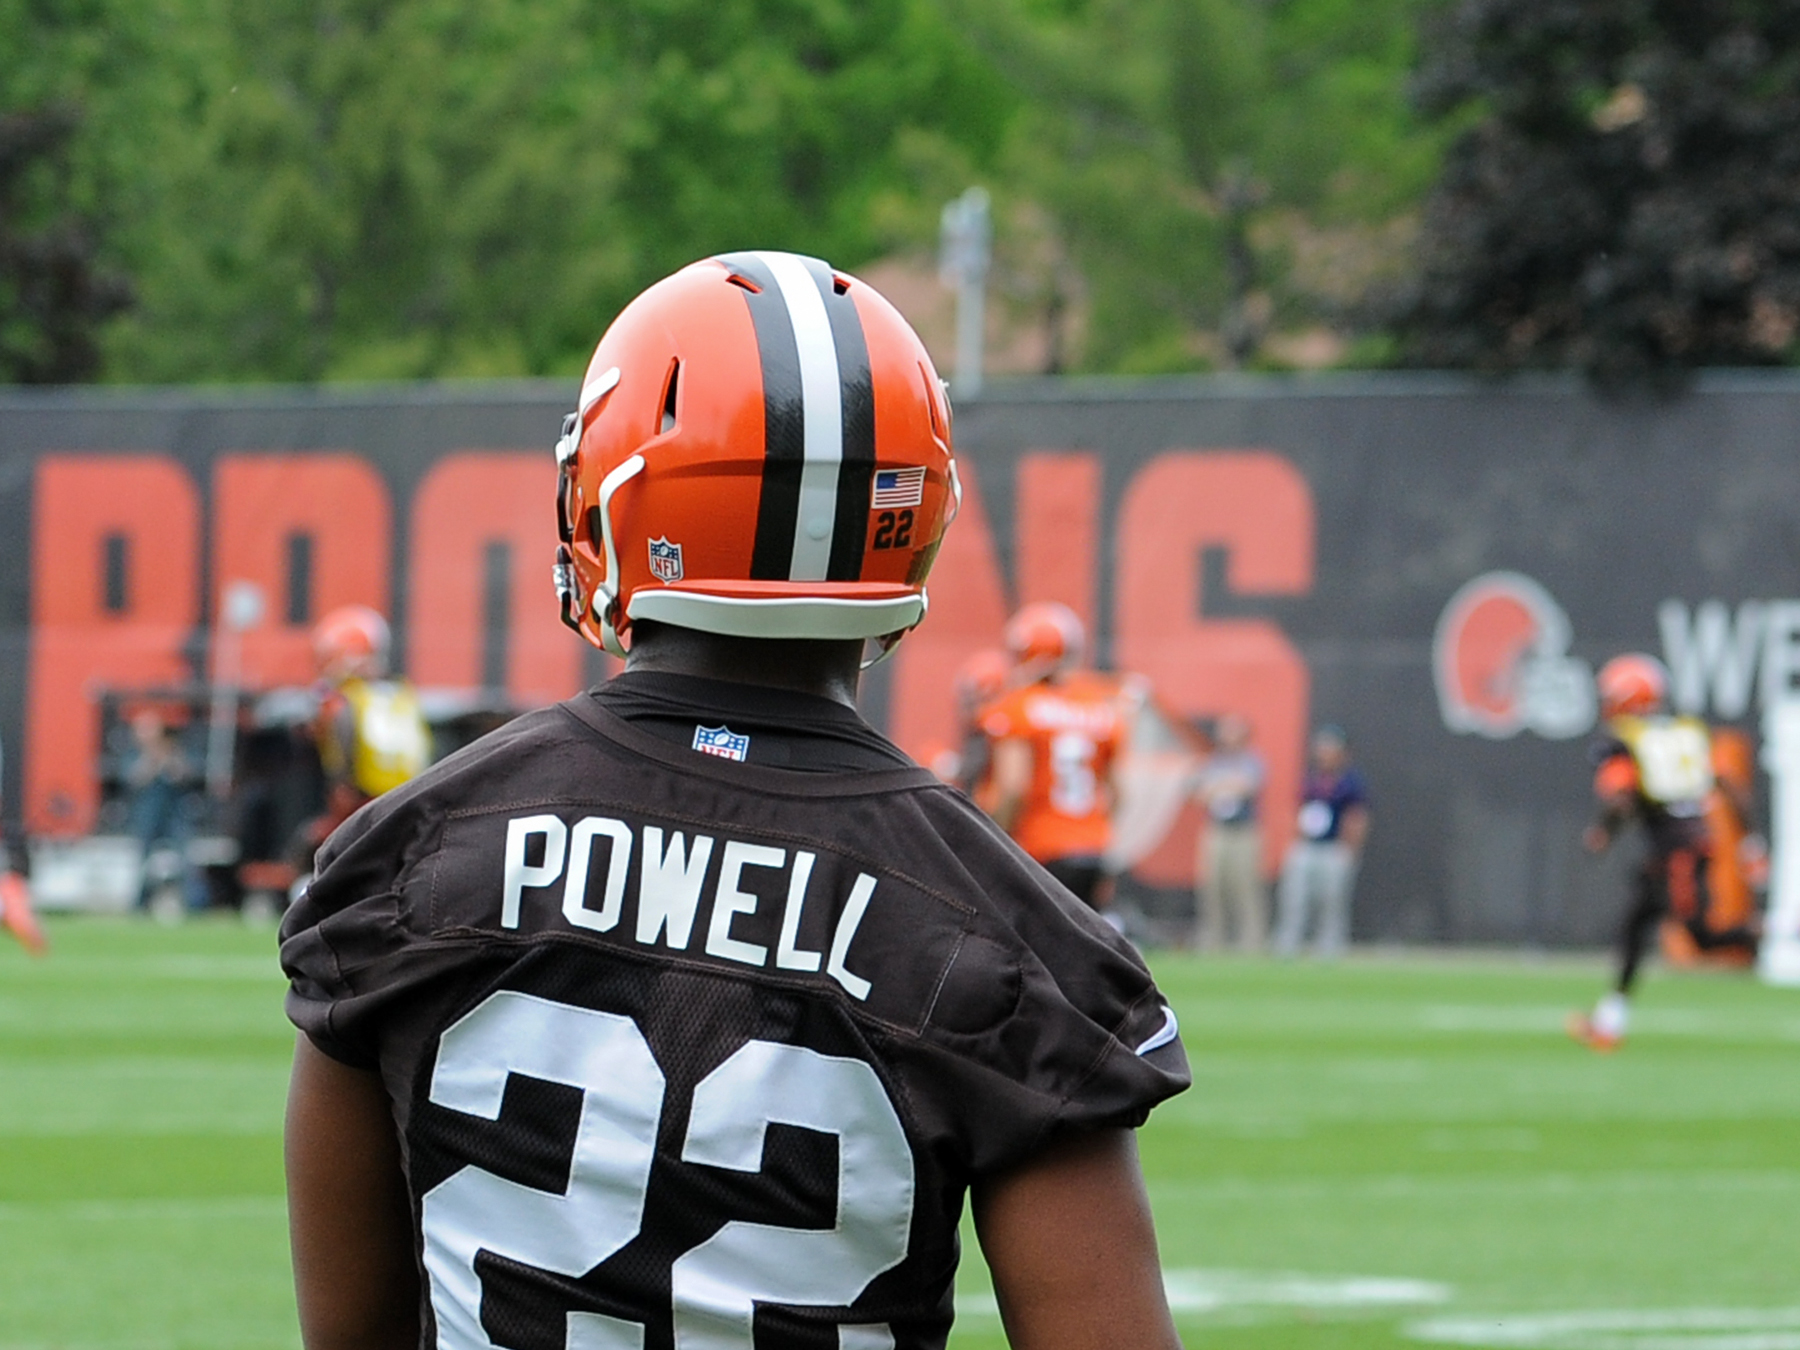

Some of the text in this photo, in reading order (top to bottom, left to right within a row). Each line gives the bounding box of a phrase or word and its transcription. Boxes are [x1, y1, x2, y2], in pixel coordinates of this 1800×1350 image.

[653, 557, 678, 577] NFL
[873, 509, 914, 551] 22
[27, 453, 1318, 886] BRONS
[501, 814, 877, 1001] POWELL
